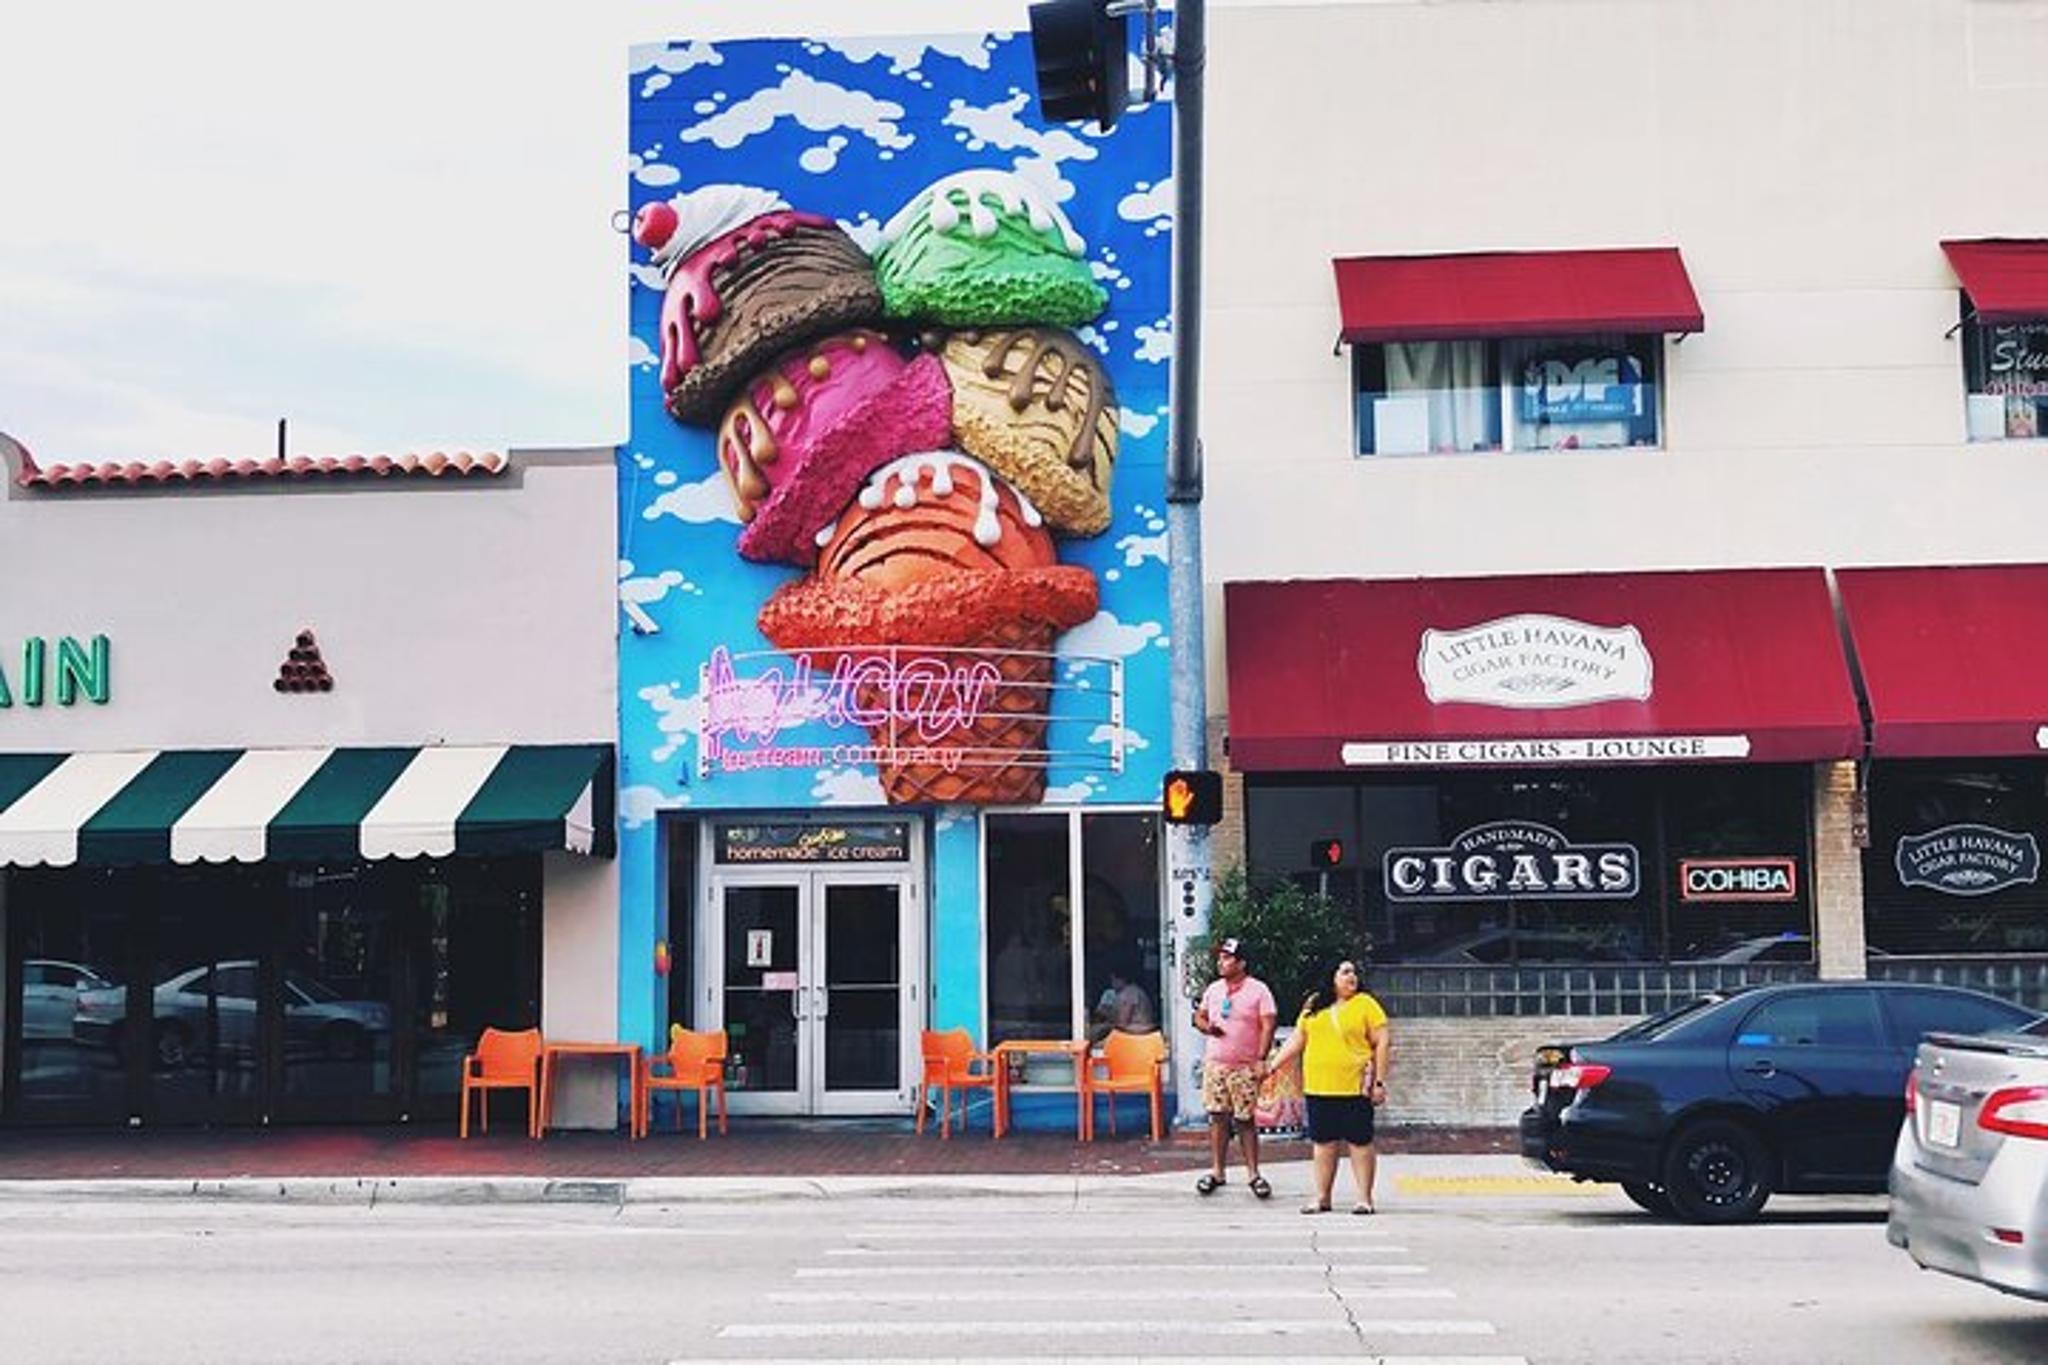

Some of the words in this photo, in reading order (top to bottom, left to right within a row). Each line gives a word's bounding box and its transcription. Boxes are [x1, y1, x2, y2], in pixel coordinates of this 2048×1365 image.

[1438, 630, 1518, 664] LITTLE
[1524, 628, 1626, 661] HAVANA
[0, 634, 110, 708] IN
[1452, 655, 1513, 682] CIGAR
[1519, 653, 1617, 680] FACTORY
[1387, 743, 1451, 762] FINE
[1458, 740, 1562, 761] CIGARS
[1585, 738, 1706, 758] LOUNGE
[727, 845, 819, 860] homemade
[827, 845, 850, 860] ice
[852, 846, 902, 859] cream
[1462, 827, 1560, 853] HANDMADE
[1908, 837, 1957, 864] LITTLE
[1961, 836, 2023, 862] HAVANA
[1391, 851, 1634, 893] CIGARS
[1917, 854, 1958, 876] CIGAR
[1959, 852, 2019, 874] FACTORY
[1687, 868, 1790, 892] COHIBA
